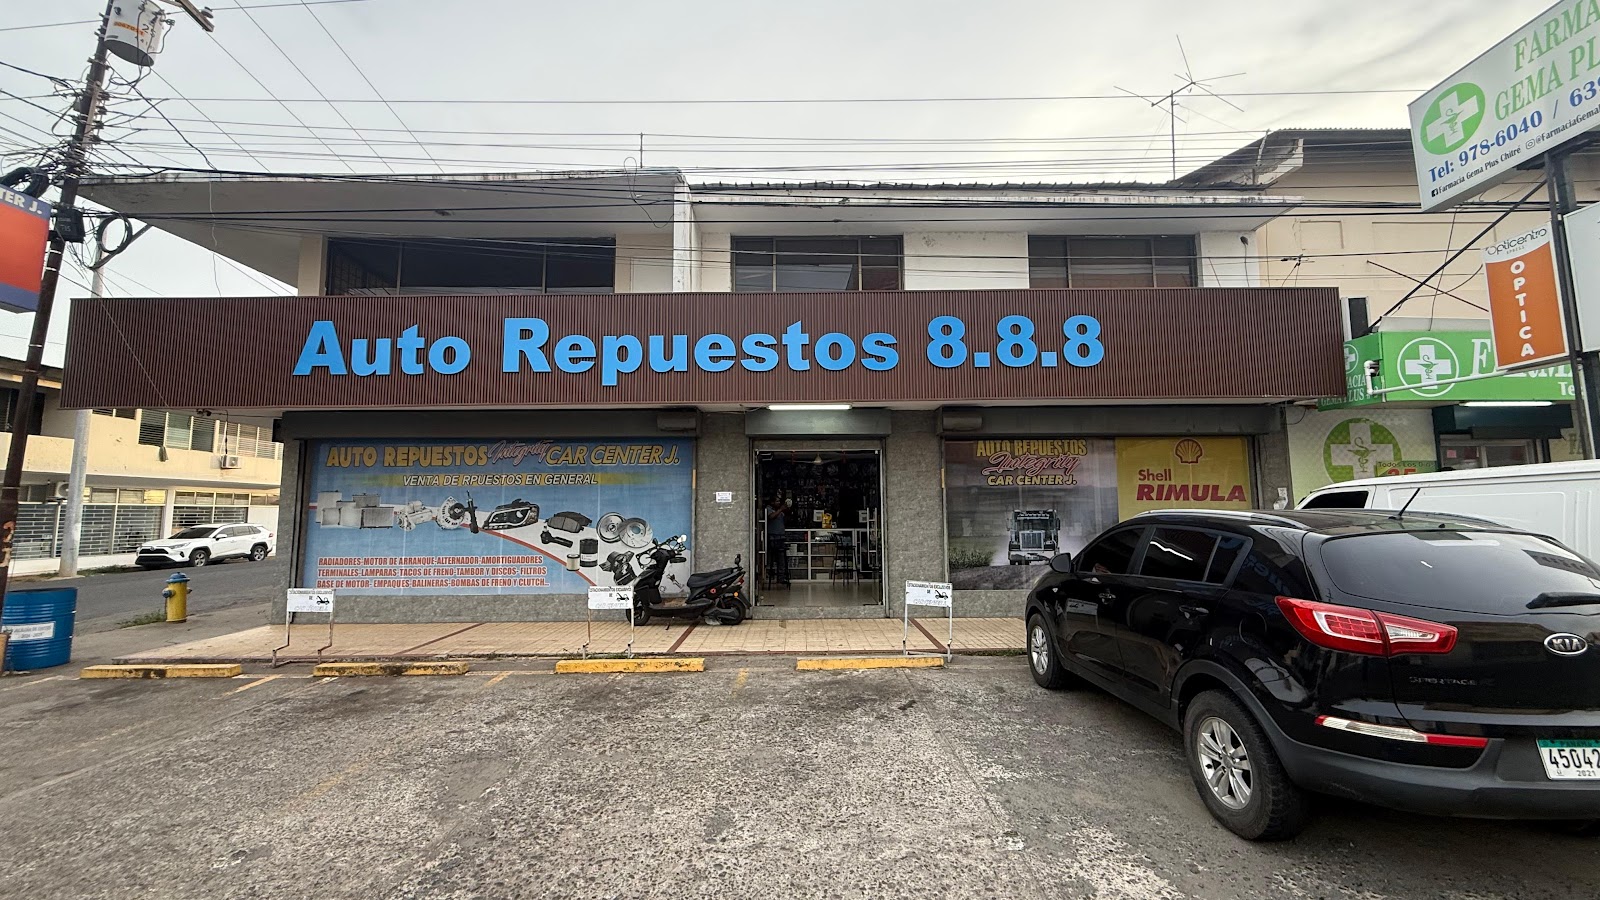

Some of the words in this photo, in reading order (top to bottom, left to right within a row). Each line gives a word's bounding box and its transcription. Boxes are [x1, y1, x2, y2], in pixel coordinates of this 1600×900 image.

[1495, 60, 1563, 120] GEMA
[1428, 160, 1455, 182] Tel:
[1459, 110, 1543, 167] 978-6040
[1569, 77, 1600, 107] 63
[1439, 176, 1465, 194] Farmacia
[1466, 166, 1484, 180] Gema
[1484, 158, 1499, 171] Plus
[1536, 103, 1600, 144] @FarmaciaGema
[29, 200, 43, 215] J.
[1486, 228, 1547, 255] Opticentro
[1510, 260, 1535, 357] OPTICA
[292, 320, 472, 377] Auto
[502, 317, 900, 387] Repuestos
[926, 314, 1105, 369] 8.8.8
[1346, 373, 1366, 388] ACIA
[1558, 381, 1576, 396] Te
[326, 446, 378, 468] AUTO
[383, 445, 489, 467] REPUESTOS
[545, 445, 587, 466] CAR
[590, 445, 663, 465] CENTER
[663, 444, 680, 465] J.
[977, 440, 1010, 457] AUTO
[1014, 439, 1087, 457] REPUESTOS
[982, 450, 1081, 476] Integrity
[403, 475, 440, 486] VENTA
[443, 475, 458, 486] DE
[461, 474, 522, 486] RPUESTOS
[525, 474, 541, 485] EN
[544, 473, 598, 485] GENERAL
[987, 475, 1013, 486] CAR
[1016, 474, 1064, 486] CENTER
[1065, 474, 1078, 486] J.
[1138, 468, 1172, 482] Shell
[1136, 484, 1247, 502] RIMULA
[389, 557, 397, 565] DE
[423, 568, 431, 576] DE
[486, 567, 489, 575] Y
[520, 566, 547, 575] FILTROS
[317, 580, 334, 588] BASE
[335, 580, 344, 588] DE
[481, 578, 490, 587] DE
[491, 578, 511, 587] FRENO
[513, 578, 517, 587] Y
[1552, 638, 1582, 651] KIA
[1549, 748, 1600, 769] 45042
